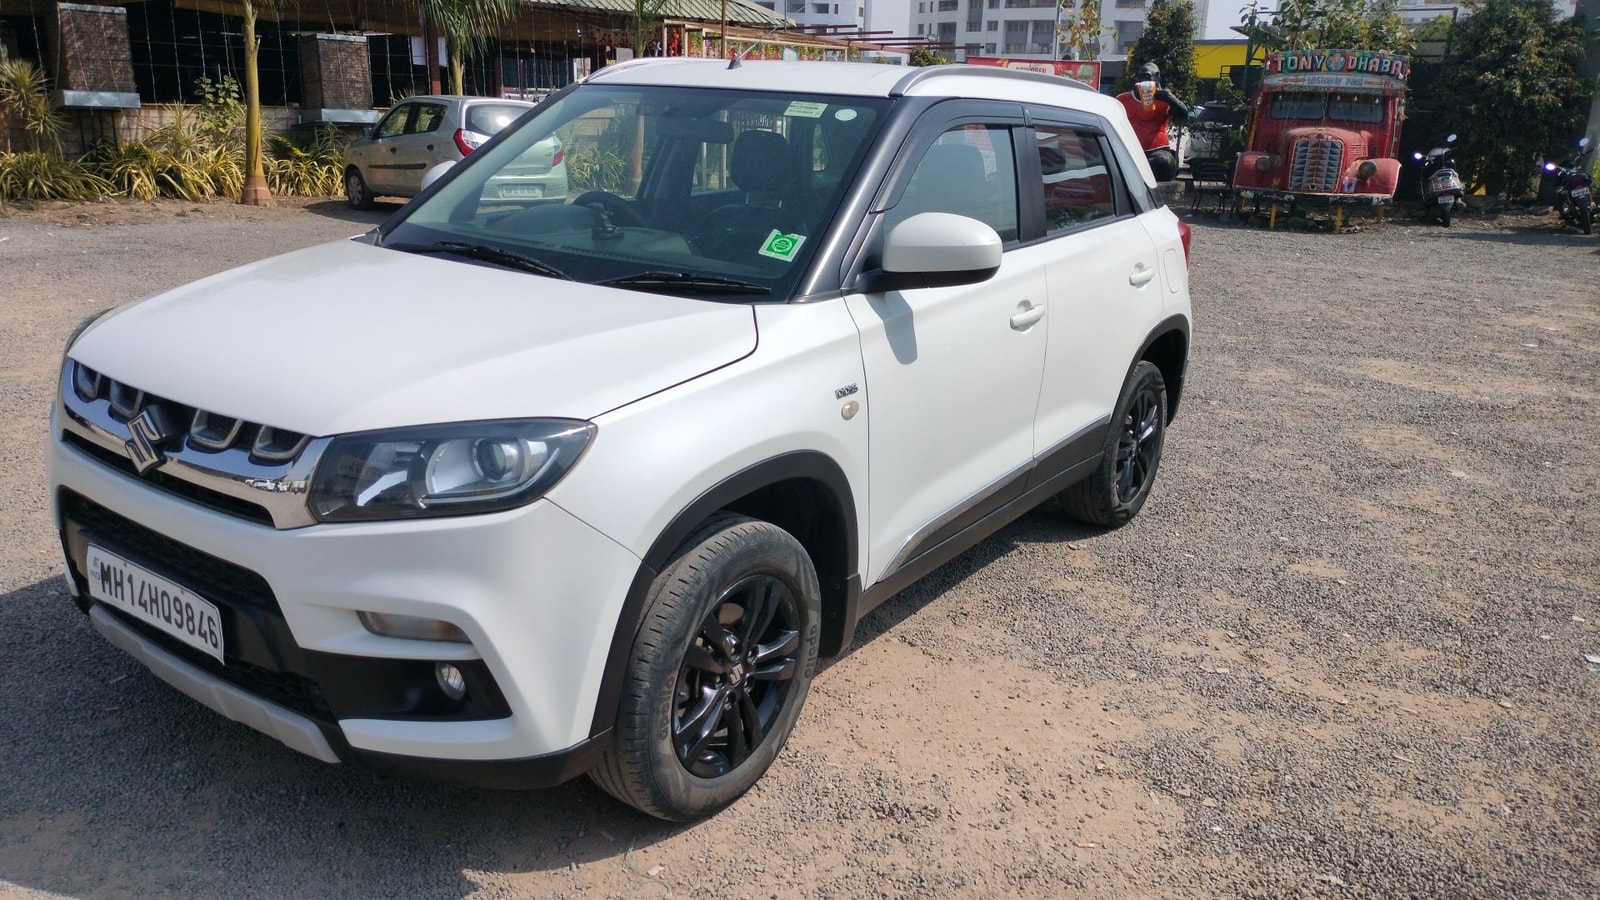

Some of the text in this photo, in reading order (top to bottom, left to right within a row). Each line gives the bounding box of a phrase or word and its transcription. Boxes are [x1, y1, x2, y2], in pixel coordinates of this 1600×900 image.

[1274, 54, 1403, 75] TONY DHABA
[100, 561, 219, 649] MH14HQ9846
